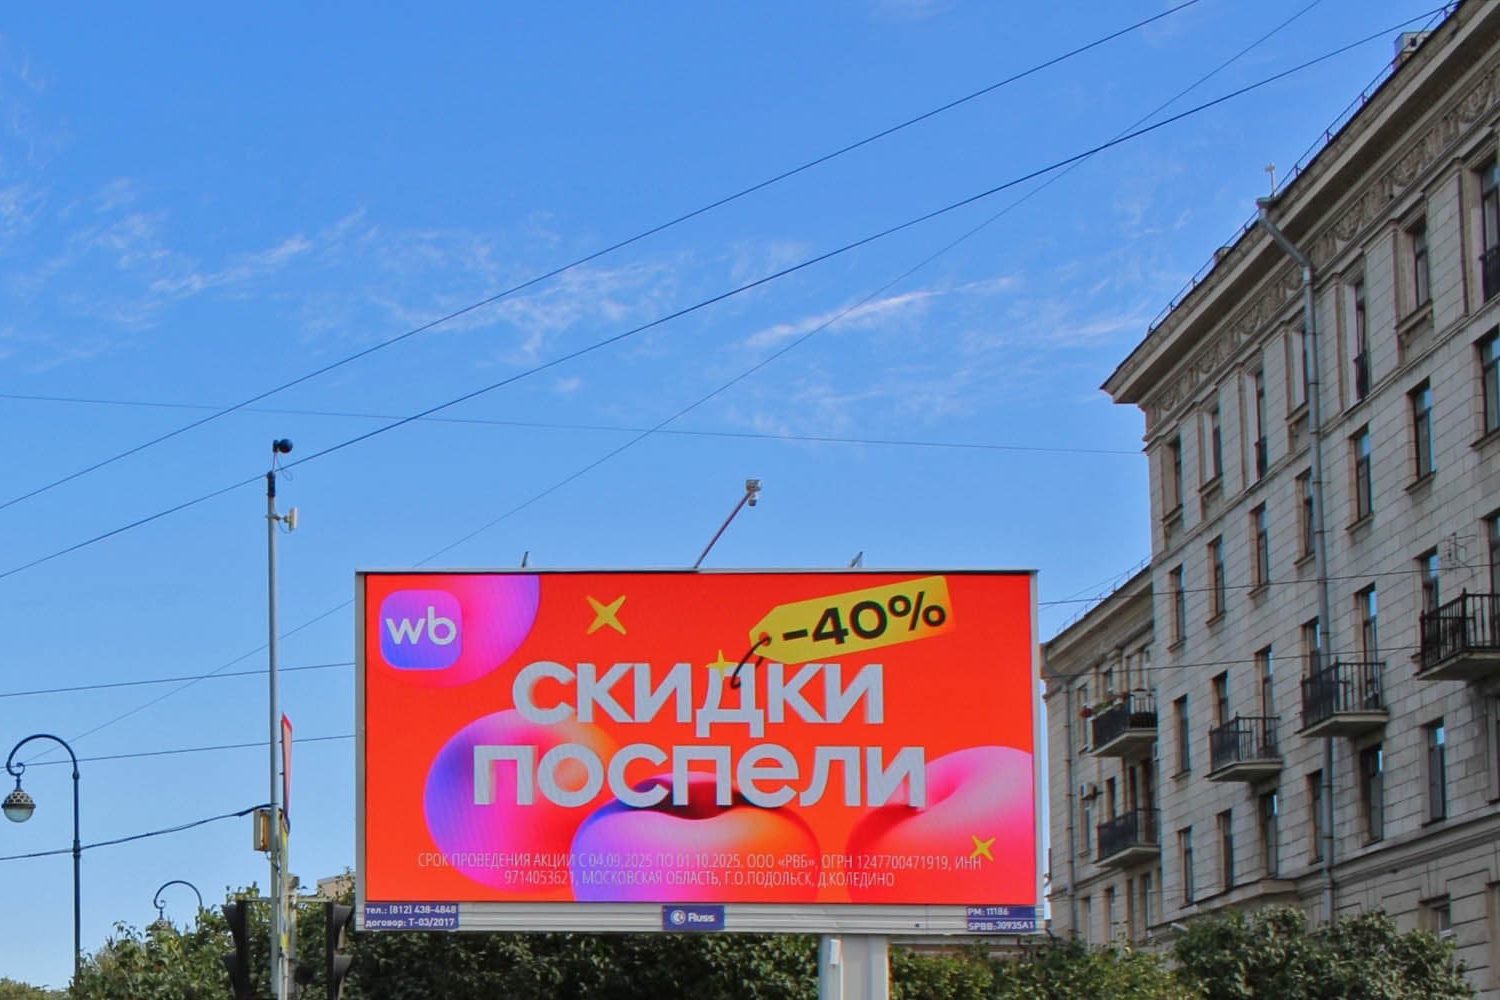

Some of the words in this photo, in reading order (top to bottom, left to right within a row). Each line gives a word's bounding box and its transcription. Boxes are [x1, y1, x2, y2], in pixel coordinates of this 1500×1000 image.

[385, 606, 457, 646] wb
[782, 591, 947, 645] -40%
[512, 661, 884, 738] скидки
[473, 743, 926, 809] поспели
[418, 853, 449, 867] СРОК
[451, 853, 530, 869] ПРОВЕДЕНИЯ
[534, 853, 575, 869] АКЦИИ
[656, 854, 674, 868] ПО
[747, 854, 775, 868] ООО
[821, 854, 853, 868] ОГРН
[955, 856, 982, 869] ИНН
[582, 871, 662, 885] МОСКОВСКАЯ
[667, 871, 722, 887] ОБЛАСТЬ,
[688, 912, 715, 923] Russ
